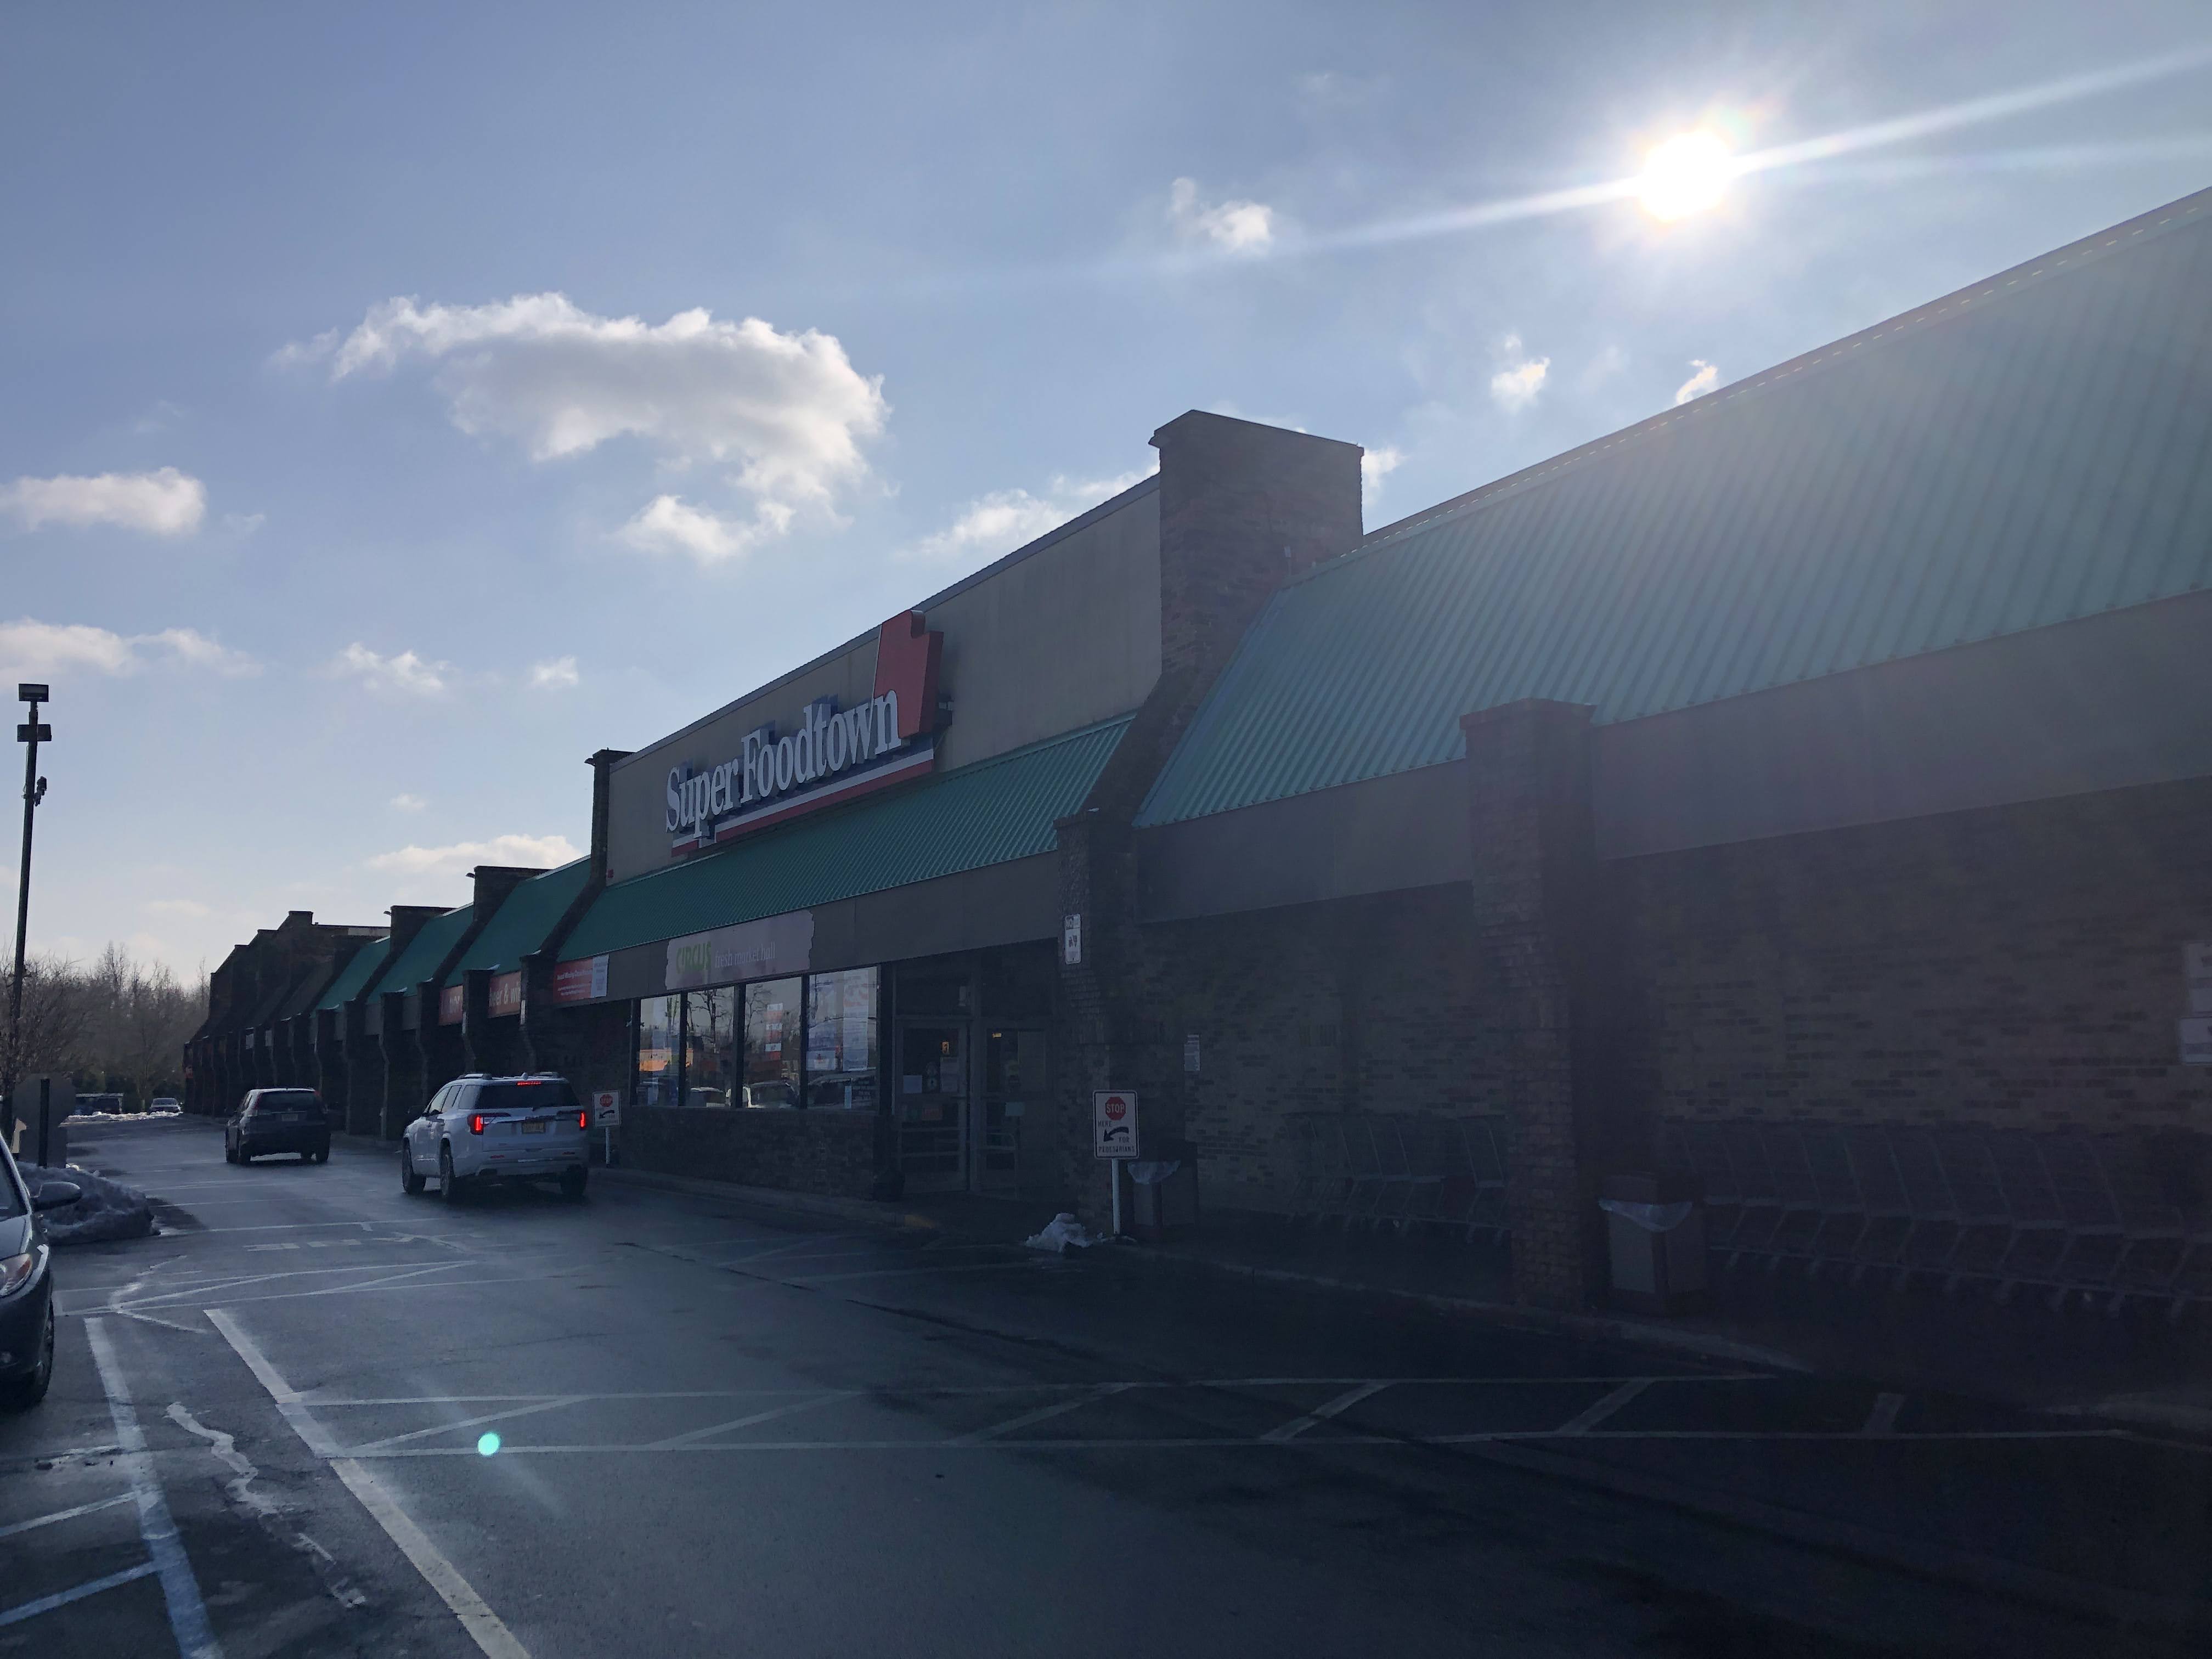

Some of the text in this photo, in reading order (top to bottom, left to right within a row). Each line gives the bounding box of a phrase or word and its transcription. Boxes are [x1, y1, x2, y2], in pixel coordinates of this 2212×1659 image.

[666, 690, 902, 838] Super Foodtown
[715, 949, 733, 968] fresh
[734, 946, 759, 966] market
[1106, 1103, 1125, 1114] STOP
